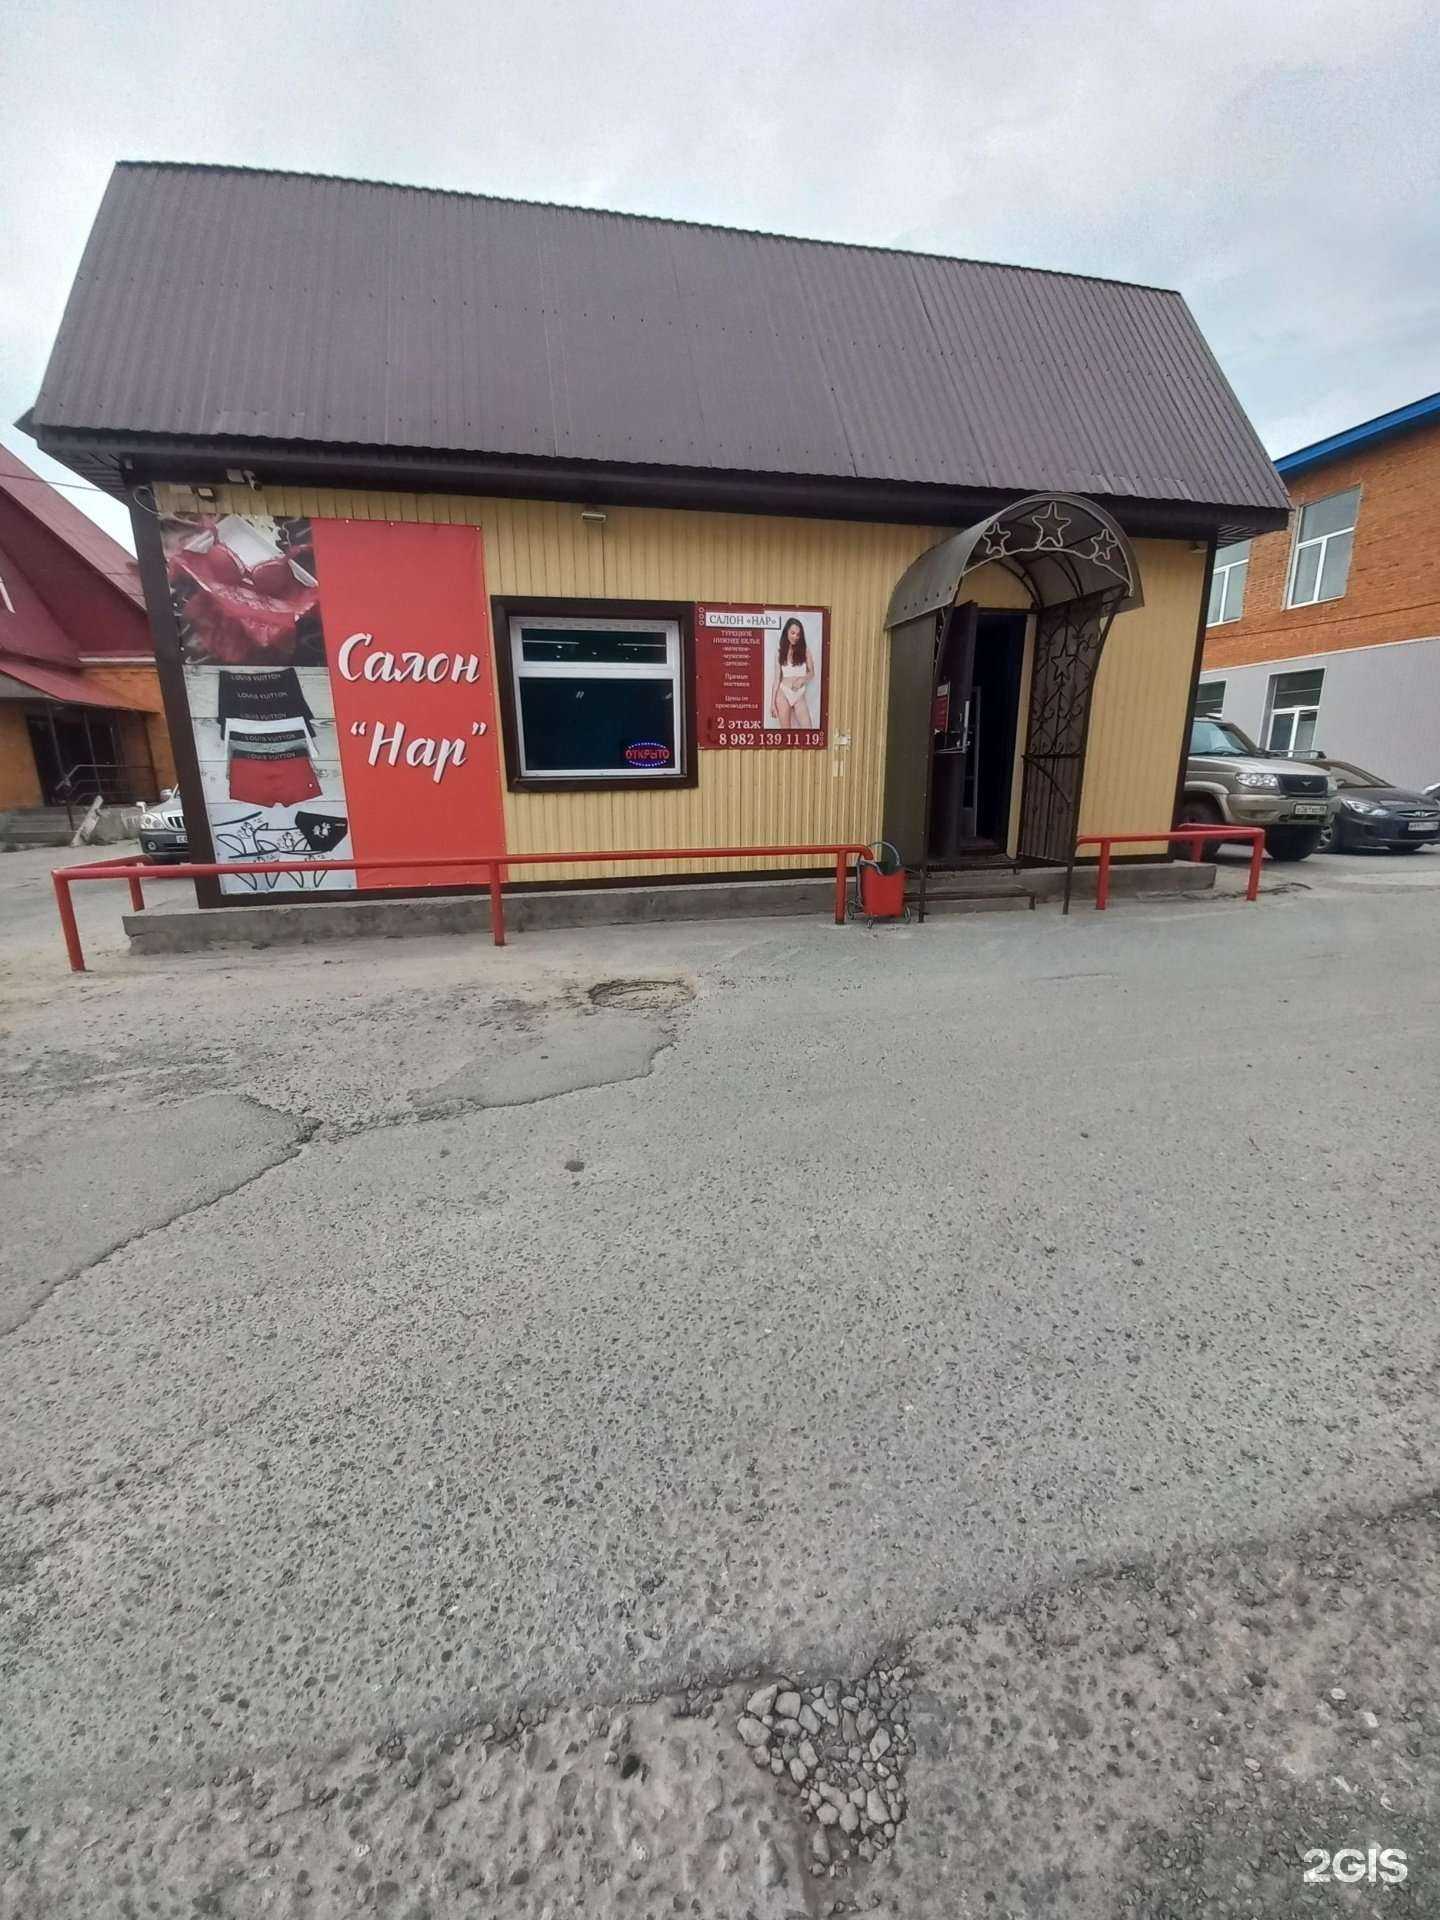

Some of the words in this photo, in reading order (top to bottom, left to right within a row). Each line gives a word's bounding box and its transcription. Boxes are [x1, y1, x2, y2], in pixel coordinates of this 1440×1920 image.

[709, 615, 744, 625] САЛОН
[337, 632, 480, 684] Салон
[717, 716, 725, 729] 2
[727, 718, 762, 730] этаж
[719, 733, 727, 745] 8
[730, 733, 755, 745] 982
[758, 733, 782, 745] 139
[786, 733, 800, 745] 11
[805, 733, 819, 745] 19
[625, 749, 670, 759] ОТКРЫТО
